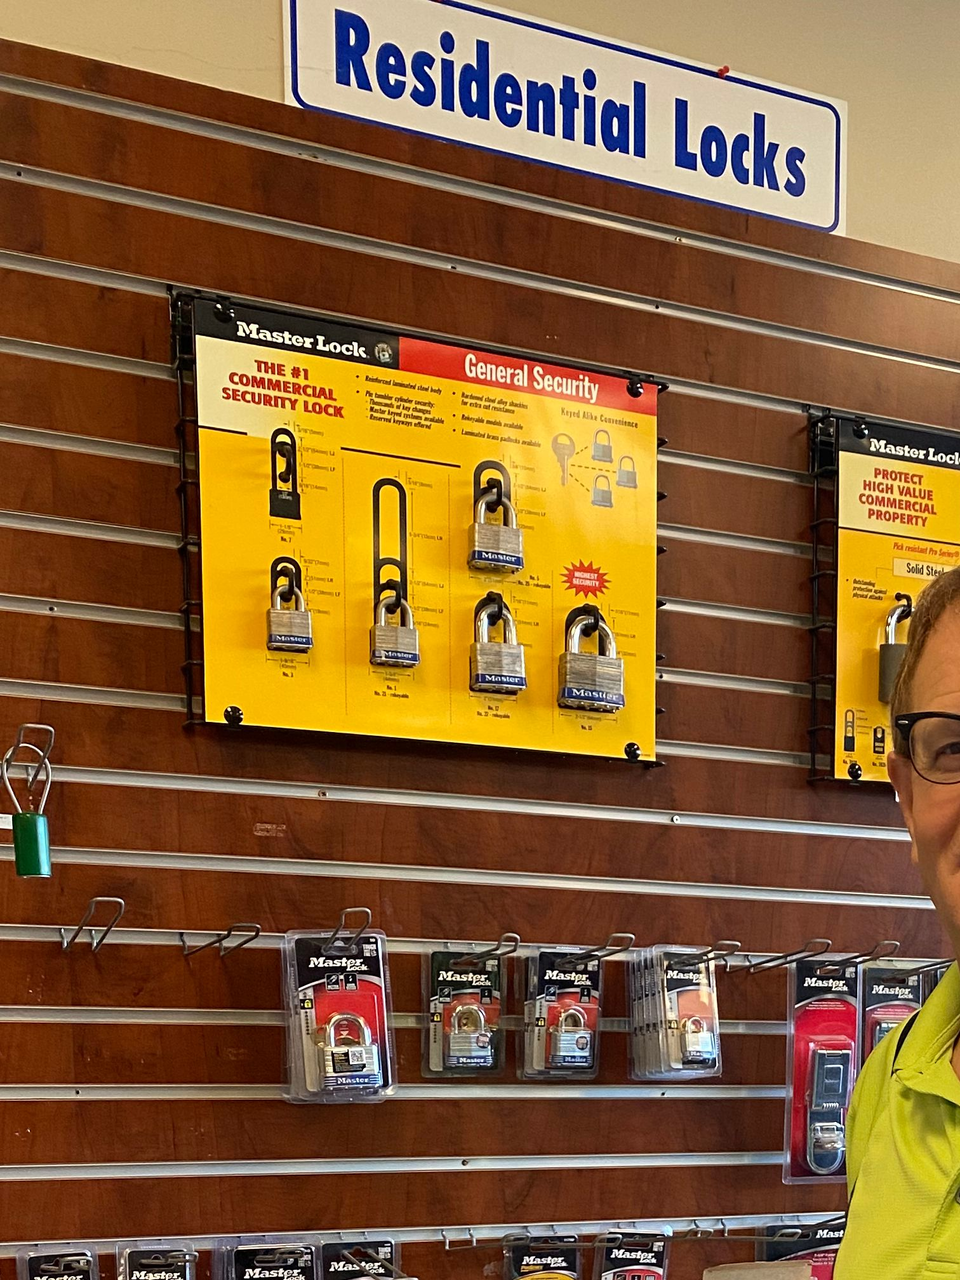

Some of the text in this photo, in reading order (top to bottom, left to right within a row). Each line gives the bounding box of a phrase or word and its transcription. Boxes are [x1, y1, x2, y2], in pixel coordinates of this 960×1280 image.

[334, 8, 805, 196] Residential Locks
[237, 321, 367, 358] Master Lock
[255, 360, 308, 380] THE #1
[465, 353, 599, 403] General Security
[229, 372, 337, 401] COMMERCIAL
[430, 386, 441, 395] body
[222, 387, 344, 418] SECURITY LOCK
[561, 407, 638, 428] Keyed Alike Convenience
[869, 438, 926, 458] Master
[874, 467, 923, 485] PROTECT
[863, 479, 933, 501] HIGH VALUE
[858, 493, 937, 515] COMMERCIAL
[867, 508, 928, 527] PROPERTY
[482, 551, 517, 562] Master
[573, 578, 599, 587] SECURITY
[853, 578, 875, 587] Outstanding
[309, 957, 363, 968] Master
[438, 970, 488, 981] Master
[544, 970, 589, 981] Master
[804, 978, 845, 987] Master
[872, 985, 910, 995] Master
[816, 1230, 844, 1238] Mast
[611, 1249, 655, 1258] Master
[522, 1256, 564, 1264] Master
[244, 1268, 301, 1280] Master
